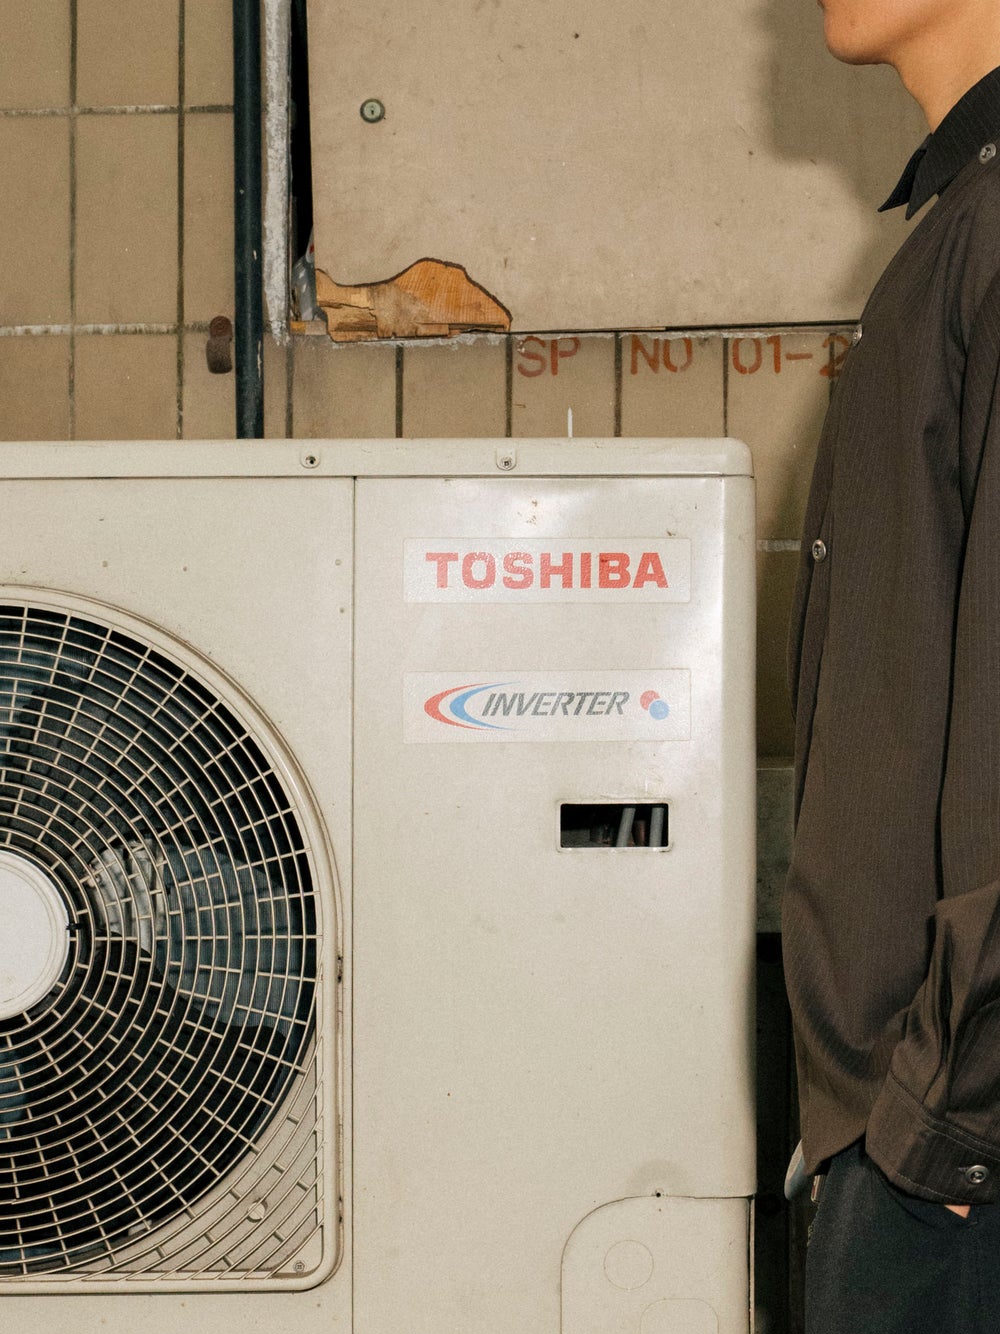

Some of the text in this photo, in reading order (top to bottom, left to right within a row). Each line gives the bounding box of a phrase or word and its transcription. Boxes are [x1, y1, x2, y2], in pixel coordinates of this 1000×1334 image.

[517, 335, 580, 377] SP
[425, 552, 669, 589] TOSHIBA
[481, 691, 630, 716] INVERTER
